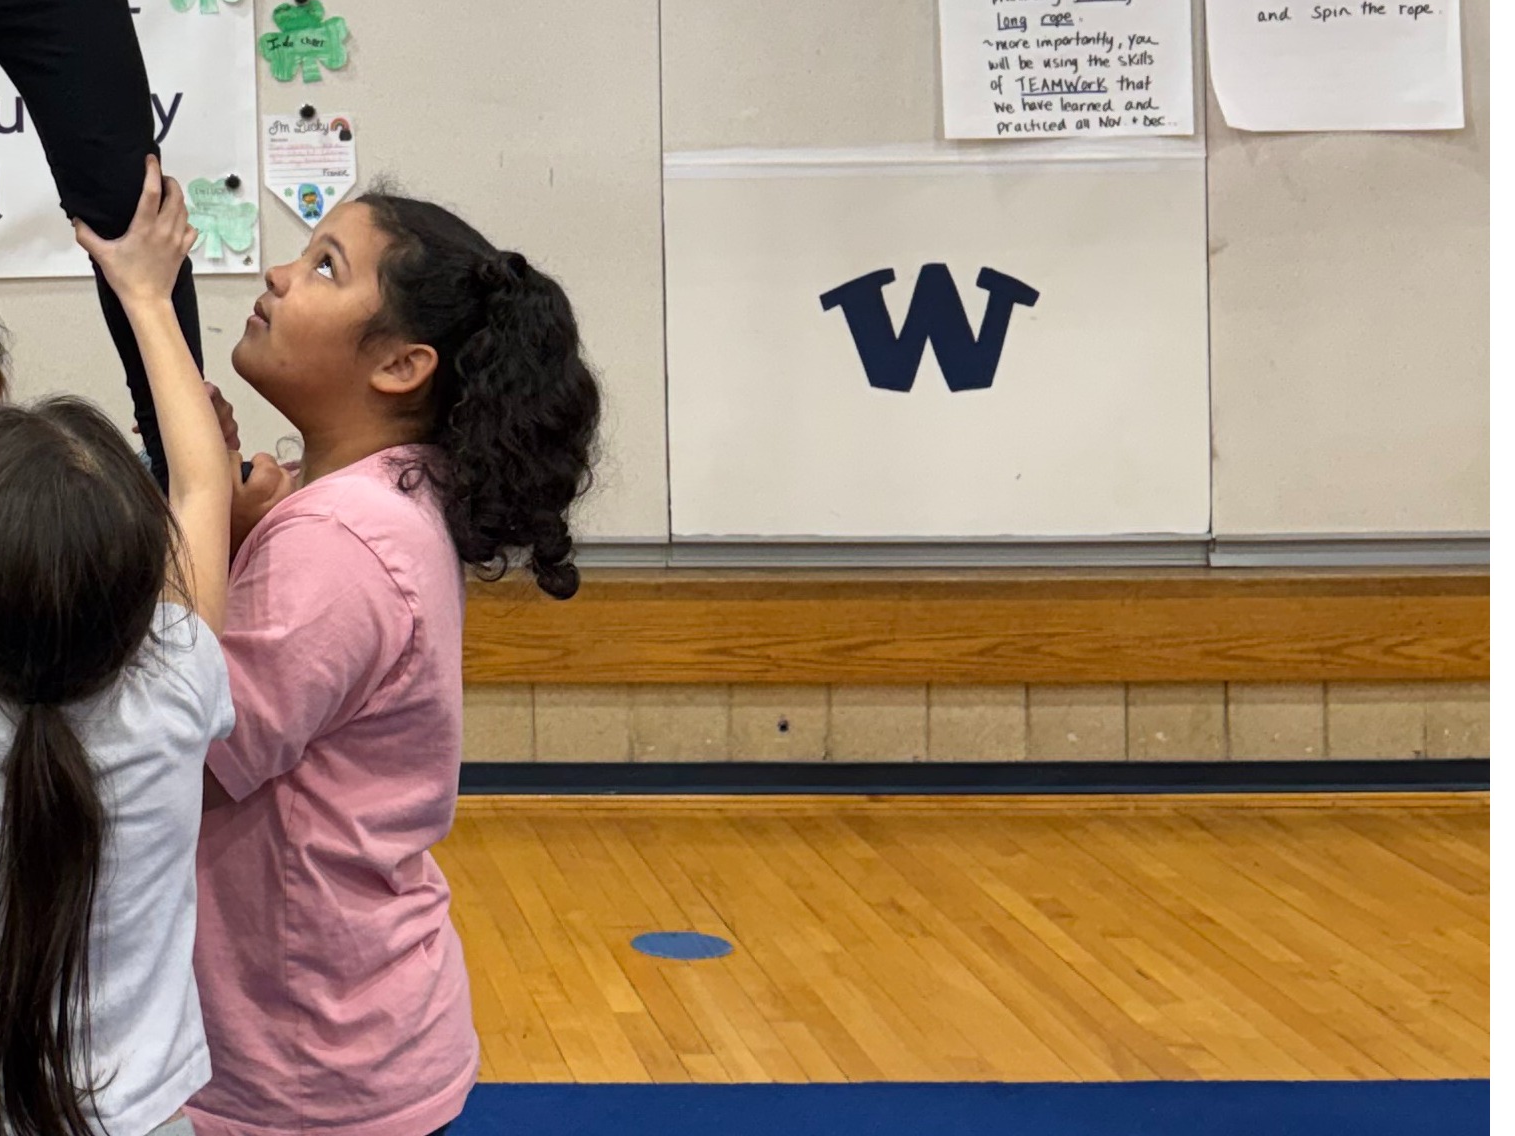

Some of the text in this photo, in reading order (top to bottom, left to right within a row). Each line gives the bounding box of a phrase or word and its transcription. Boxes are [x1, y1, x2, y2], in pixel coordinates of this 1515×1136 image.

[1257, 6, 1292, 22] and
[1361, 0, 1386, 15] the
[1127, 34, 1159, 51] you
[988, 56, 1010, 71] will
[1018, 54, 1033, 70] be
[1043, 55, 1079, 74] using
[1088, 52, 1110, 68] the
[989, 75, 1005, 94] of
[1116, 72, 1152, 92] that
[1022, 97, 1053, 113] have
[1060, 96, 1114, 113] learned
[1124, 97, 1159, 111] and
[819, 262, 1040, 393] W
